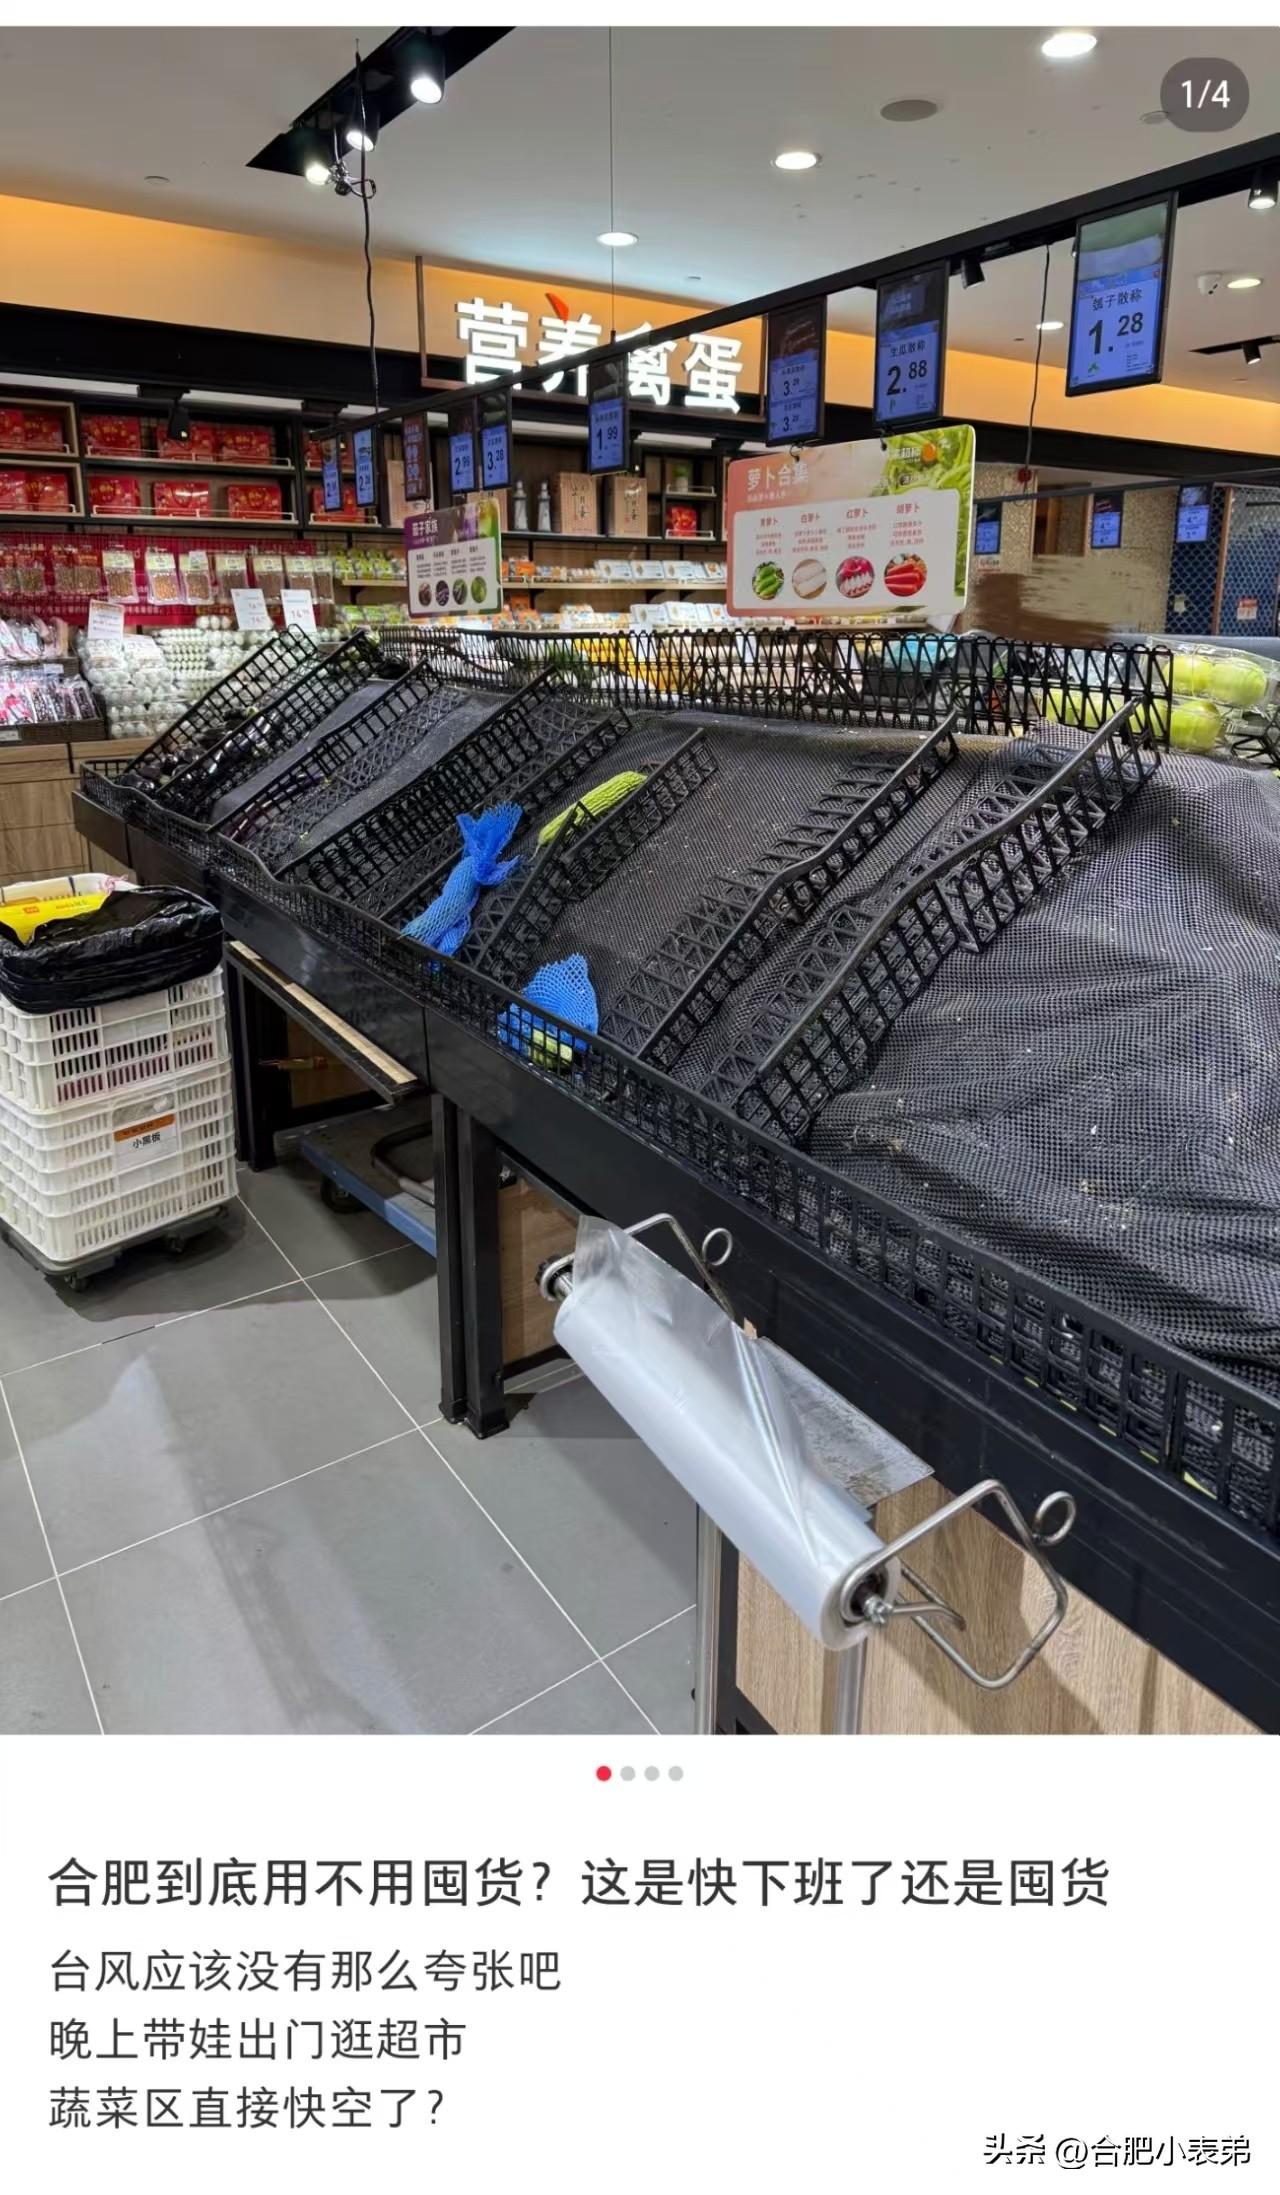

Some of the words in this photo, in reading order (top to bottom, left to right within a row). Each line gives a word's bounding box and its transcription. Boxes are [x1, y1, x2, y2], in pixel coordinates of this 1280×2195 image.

[1088, 311, 1144, 355] 1.28
[455, 292, 742, 414] 营养禽蛋
[886, 360, 928, 395] 2.88
[597, 425, 618, 451] 1.99
[747, 463, 809, 491] 萝卜合集
